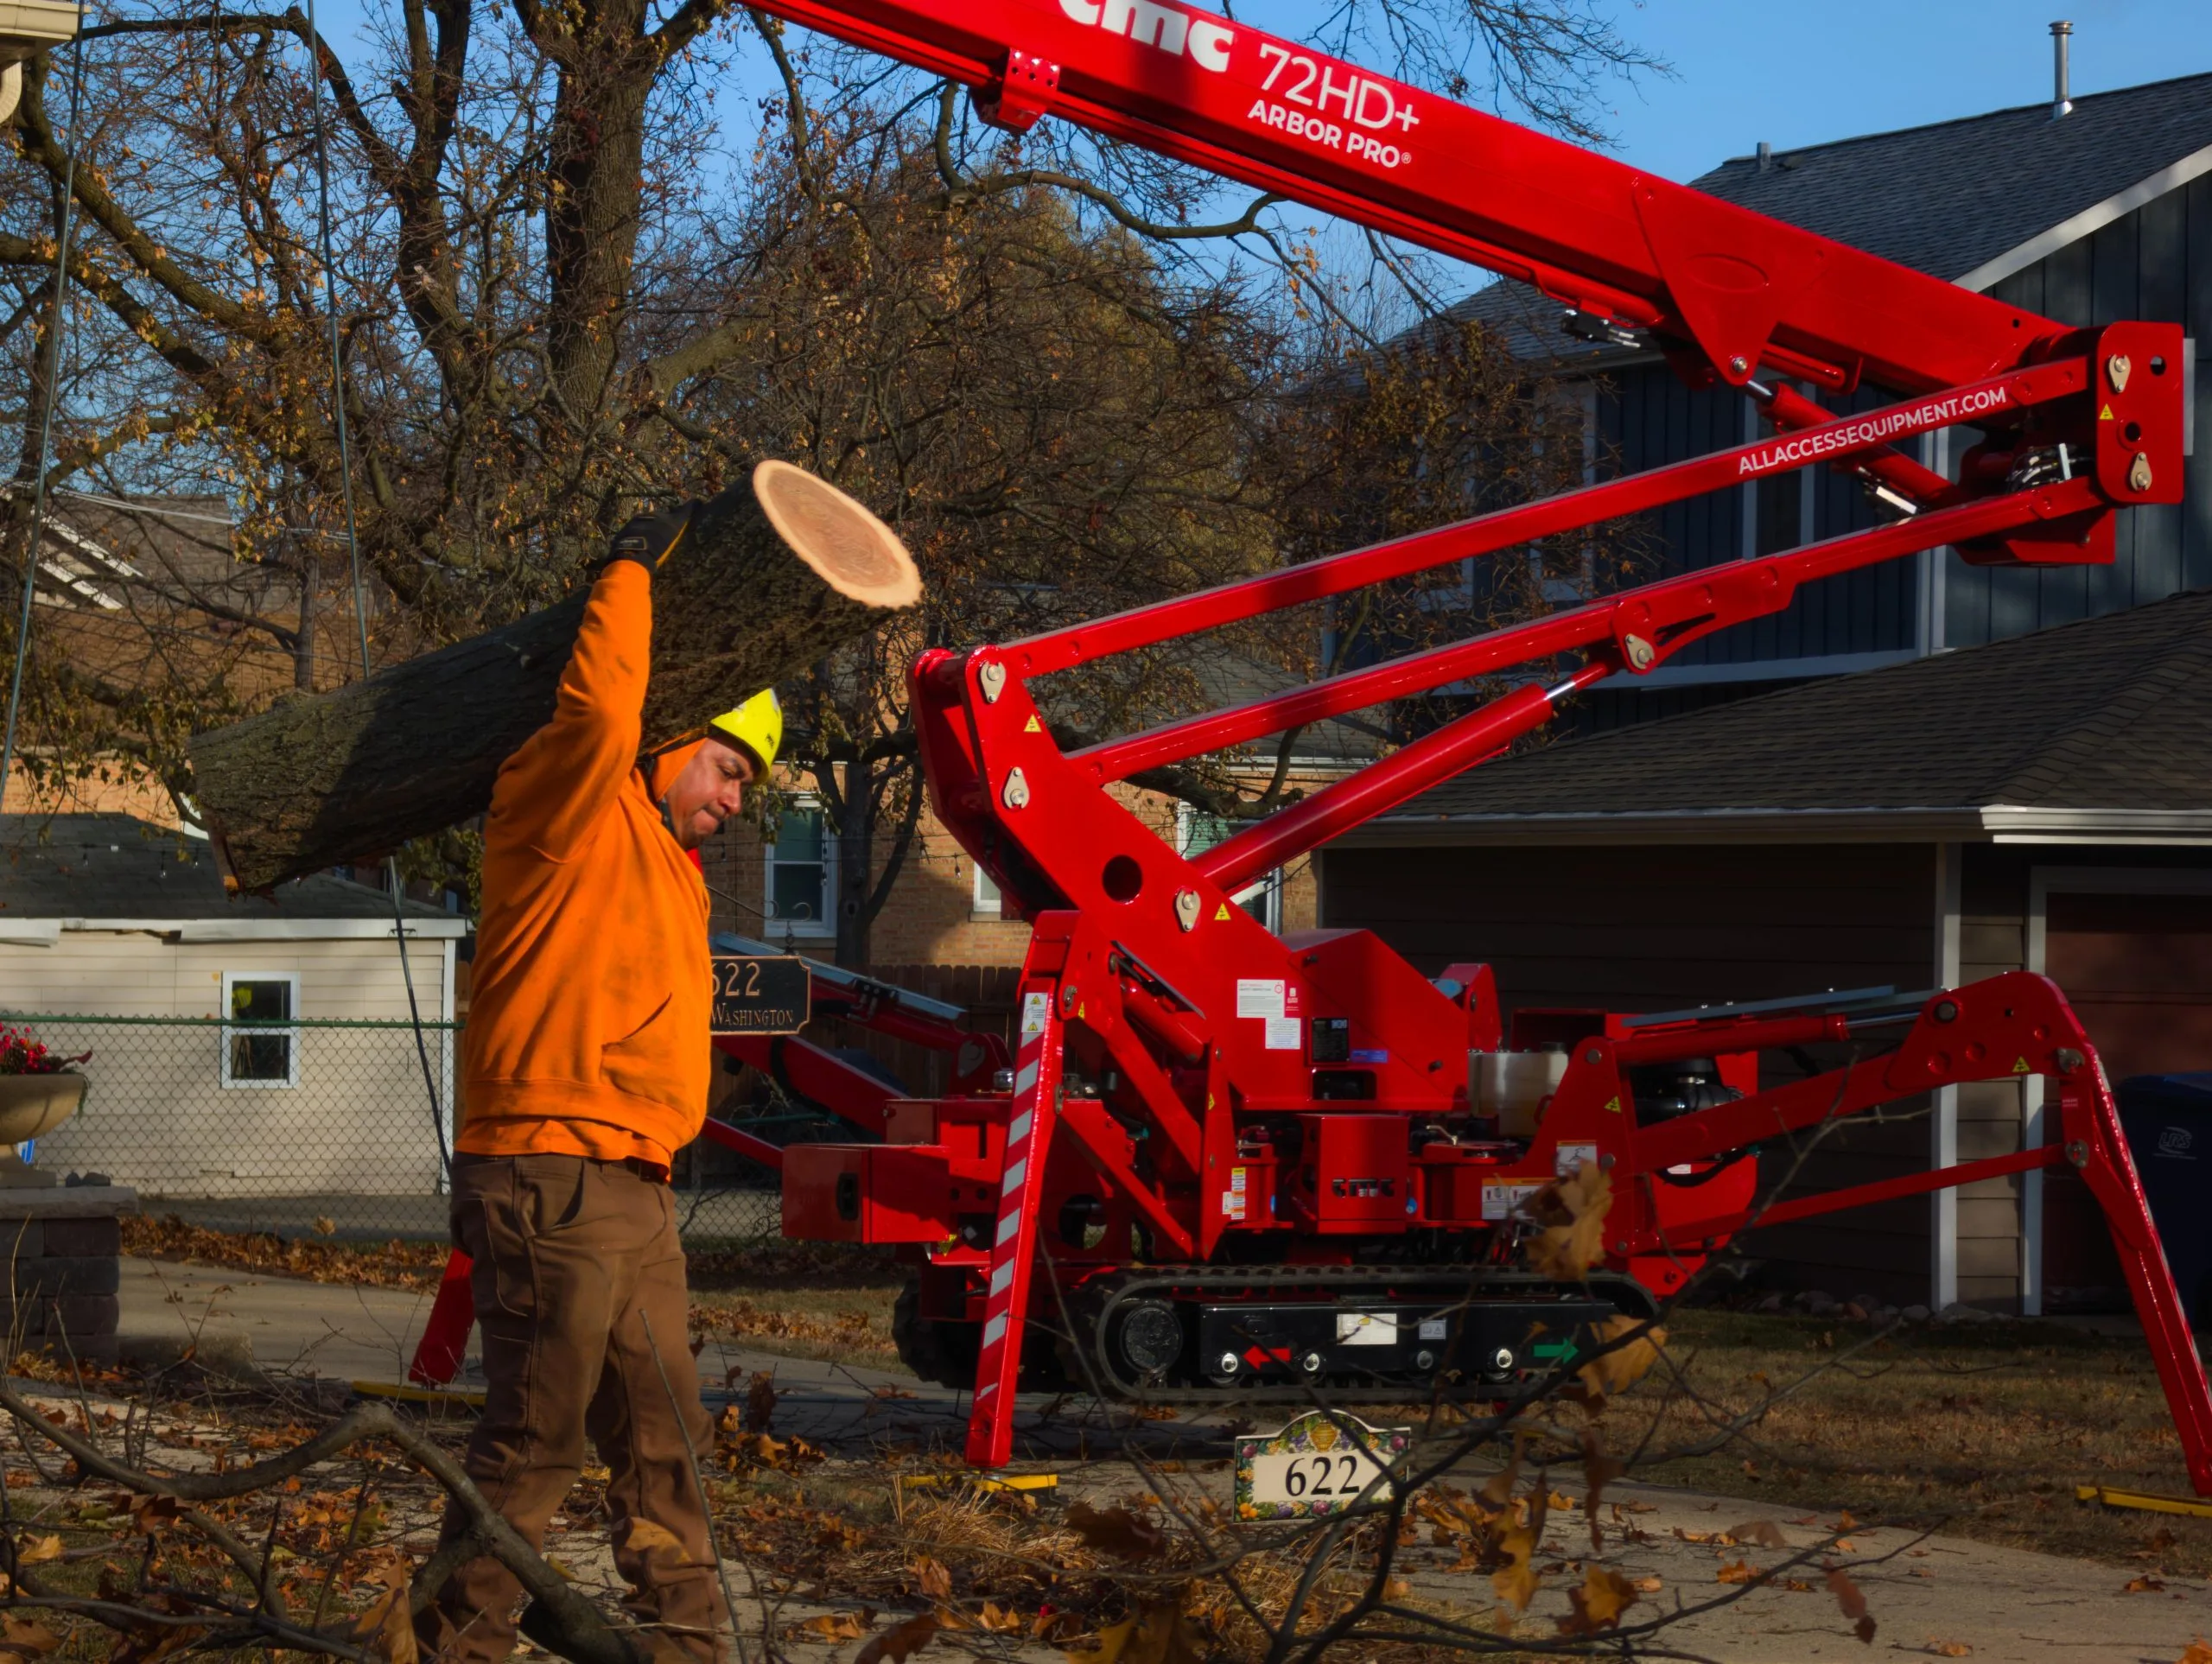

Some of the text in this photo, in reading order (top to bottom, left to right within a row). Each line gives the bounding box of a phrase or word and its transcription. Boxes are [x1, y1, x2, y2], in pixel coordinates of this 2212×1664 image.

[1259, 42, 1420, 132] 72HD+
[1248, 99, 1341, 149] ARBOR
[1739, 386, 2006, 474] ALLACCESSEQUIPMENT.COM
[1285, 1455, 1360, 1496] 622
